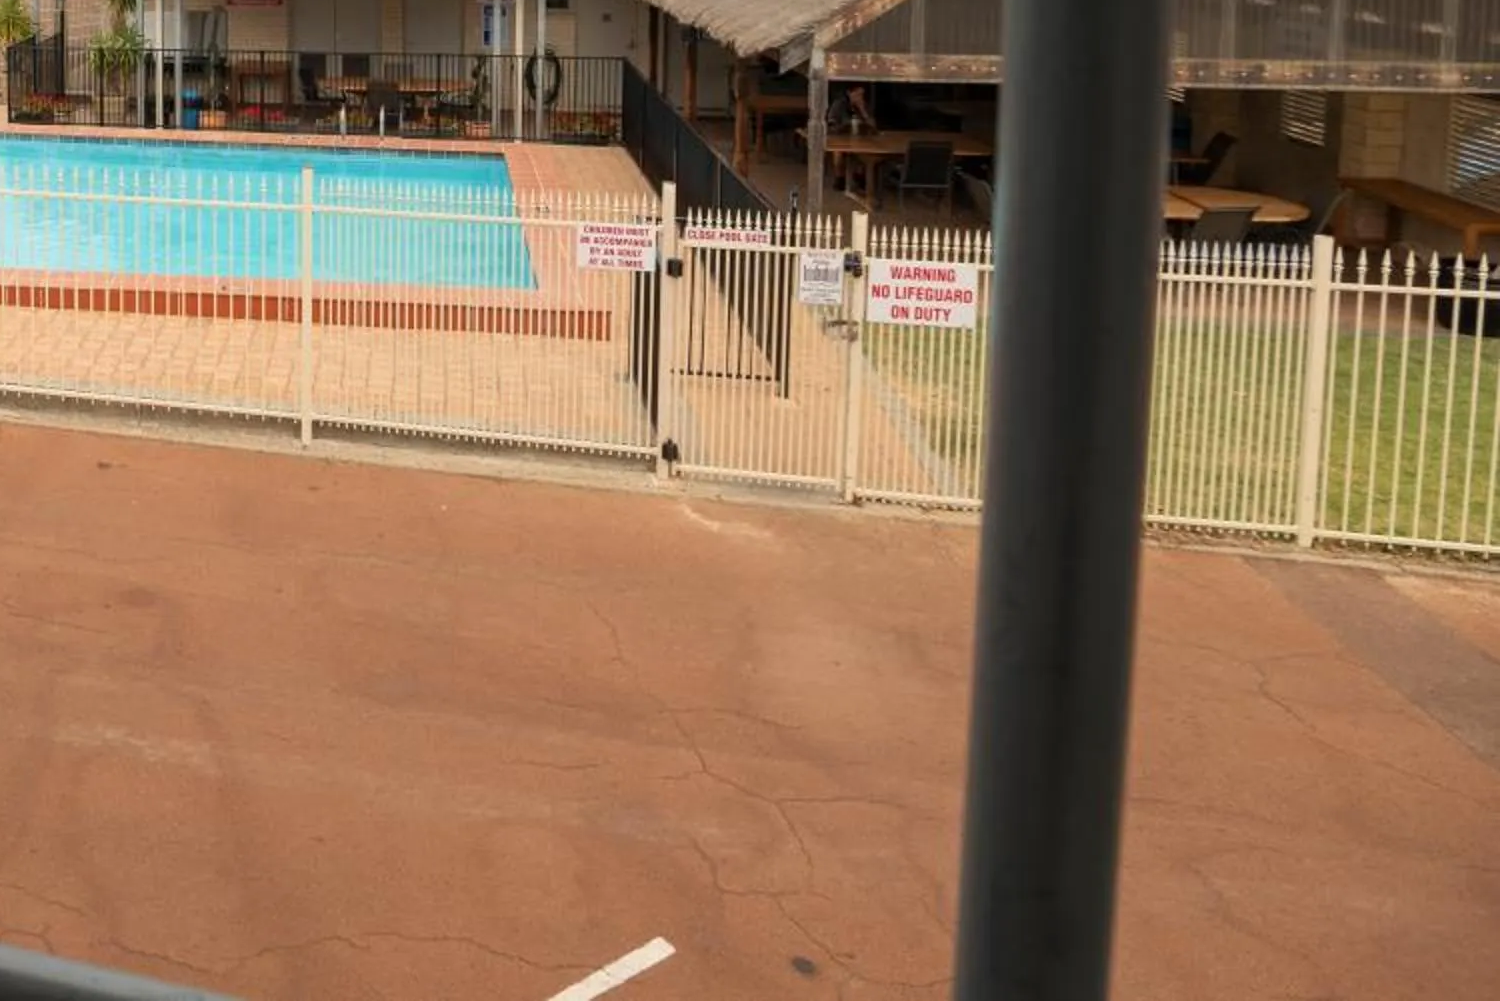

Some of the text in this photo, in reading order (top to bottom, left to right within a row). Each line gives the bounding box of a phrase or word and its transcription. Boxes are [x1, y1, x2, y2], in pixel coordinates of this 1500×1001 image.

[688, 230, 716, 240] CLOSE
[719, 231, 742, 242] POOL
[890, 266, 956, 283] WARNING
[871, 284, 973, 304] NO LIFEGUARD
[891, 305, 951, 322] ON DUTY
